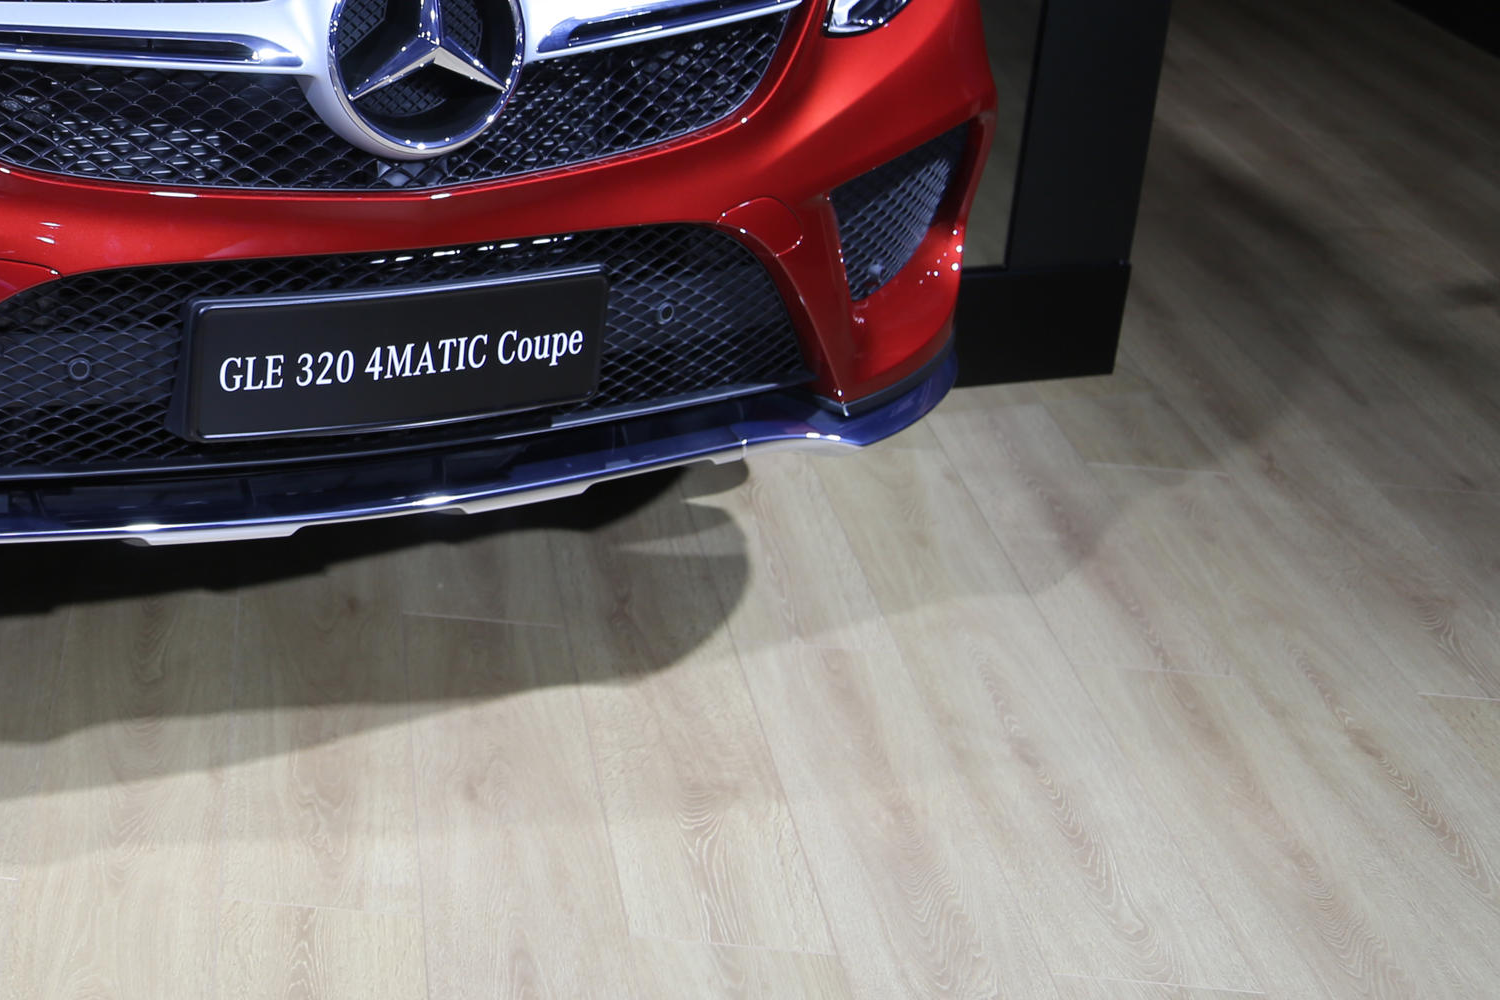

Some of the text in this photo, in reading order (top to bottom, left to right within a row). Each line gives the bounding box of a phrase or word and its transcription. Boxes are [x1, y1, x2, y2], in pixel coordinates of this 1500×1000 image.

[218, 328, 585, 392] GLE 320 4MATIC Coupe
